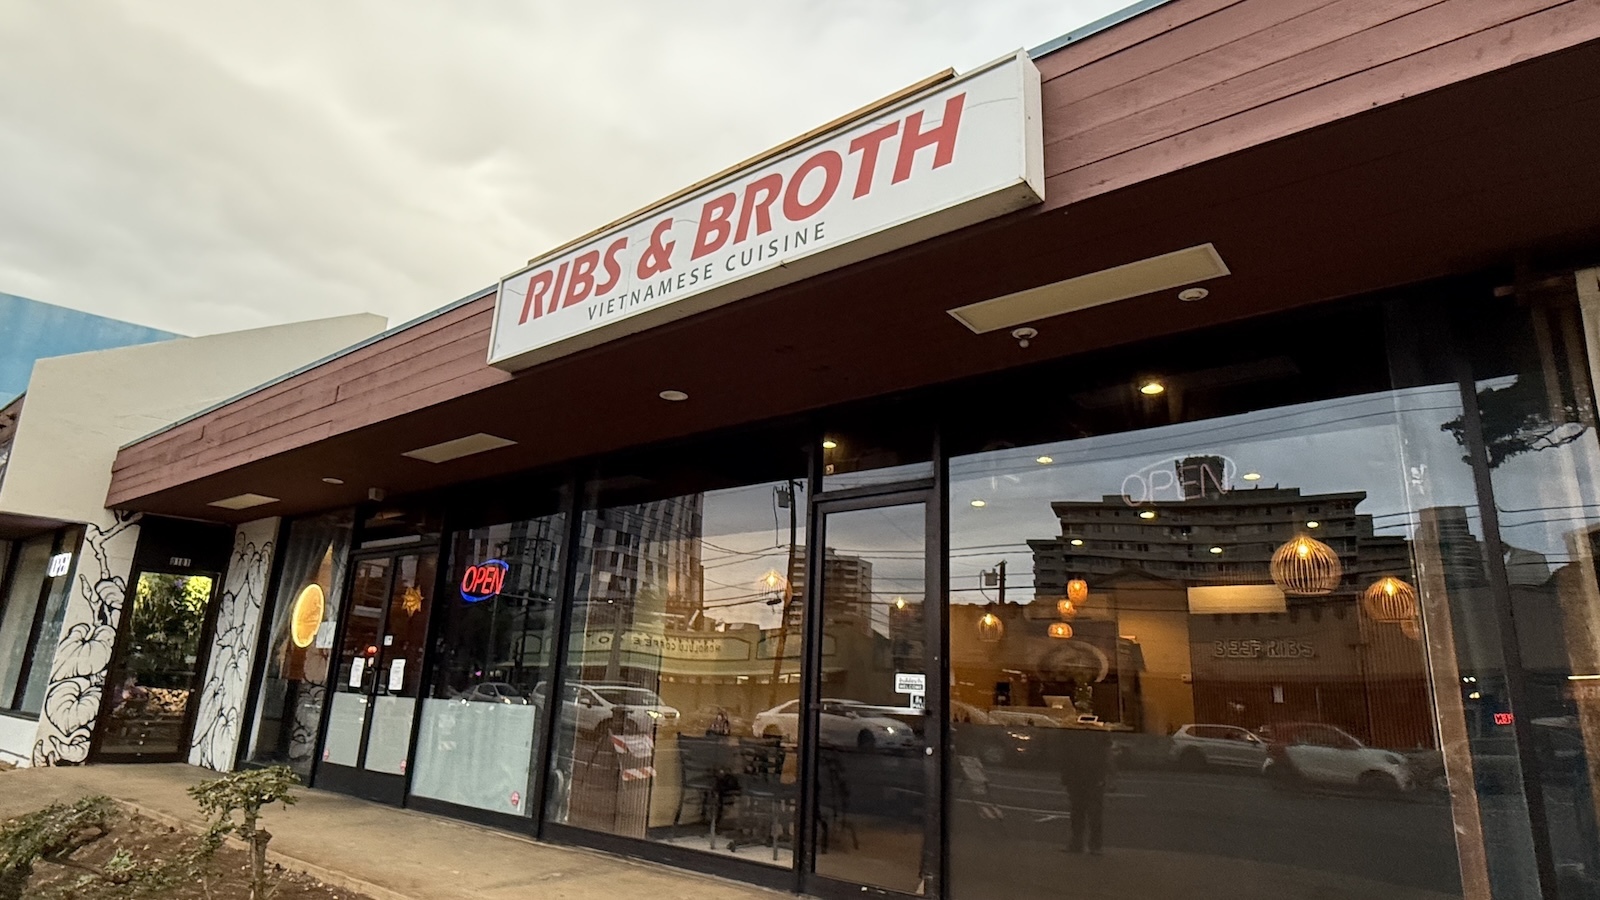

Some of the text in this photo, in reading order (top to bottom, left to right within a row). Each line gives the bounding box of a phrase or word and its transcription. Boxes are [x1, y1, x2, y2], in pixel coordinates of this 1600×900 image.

[518, 92, 967, 326] RIBS & BROTH
[588, 222, 826, 321] VIETNAMESE CUISINE
[1121, 463, 1229, 506] OPEN
[462, 565, 506, 595] OPEN
[1215, 639, 1314, 658] BEEF RIBS
